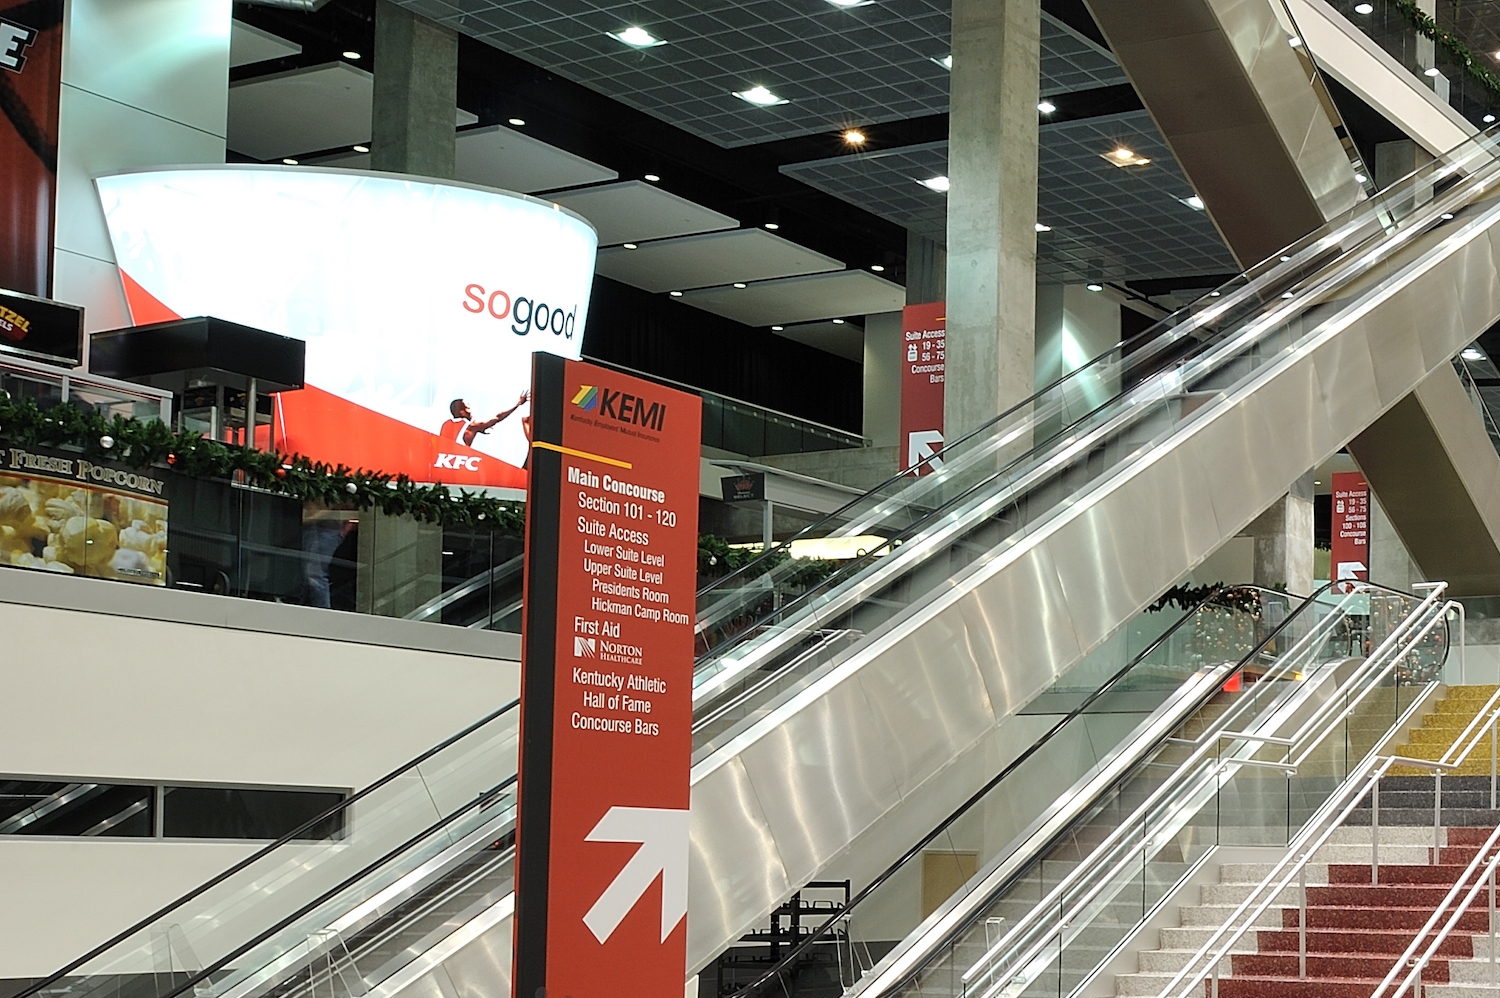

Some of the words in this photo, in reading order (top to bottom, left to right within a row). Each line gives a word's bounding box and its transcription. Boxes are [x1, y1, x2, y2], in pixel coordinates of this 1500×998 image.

[905, 331, 921, 341] Suite
[922, 330, 945, 340] Access
[922, 341, 931, 350] 19
[936, 340, 945, 349] 35
[936, 351, 945, 360] 75
[911, 364, 945, 374] Concourse
[930, 374, 945, 383] Bars
[599, 388, 667, 431] KEMI
[434, 453, 482, 471] KFC
[567, 466, 599, 489] Main
[602, 475, 665, 504] Concourse
[578, 491, 620, 515] Section
[623, 502, 643, 520] 101
[656, 509, 676, 528] 120
[577, 516, 606, 537] Suite
[608, 523, 649, 546] Access
[584, 539, 614, 558] Lower
[615, 545, 639, 563] Suite
[641, 551, 665, 568] Level
[583, 558, 612, 576] Upper
[614, 563, 637, 580] Suite
[639, 568, 663, 585] Level
[592, 578, 640, 599] Presidents
[642, 587, 669, 604] Room
[591, 597, 632, 616] Hickman
[634, 603, 661, 623] Camp
[663, 608, 689, 625] Room
[574, 616, 599, 636] First
[601, 621, 620, 639] Aid
[600, 640, 643, 657] NORTON
[573, 667, 624, 691] Kentucky
[627, 673, 667, 694] Athletic
[583, 691, 605, 709] Hall
[608, 694, 620, 710] of
[622, 695, 651, 714] Fame
[571, 712, 632, 734] Concourse
[635, 718, 659, 736] Bars
